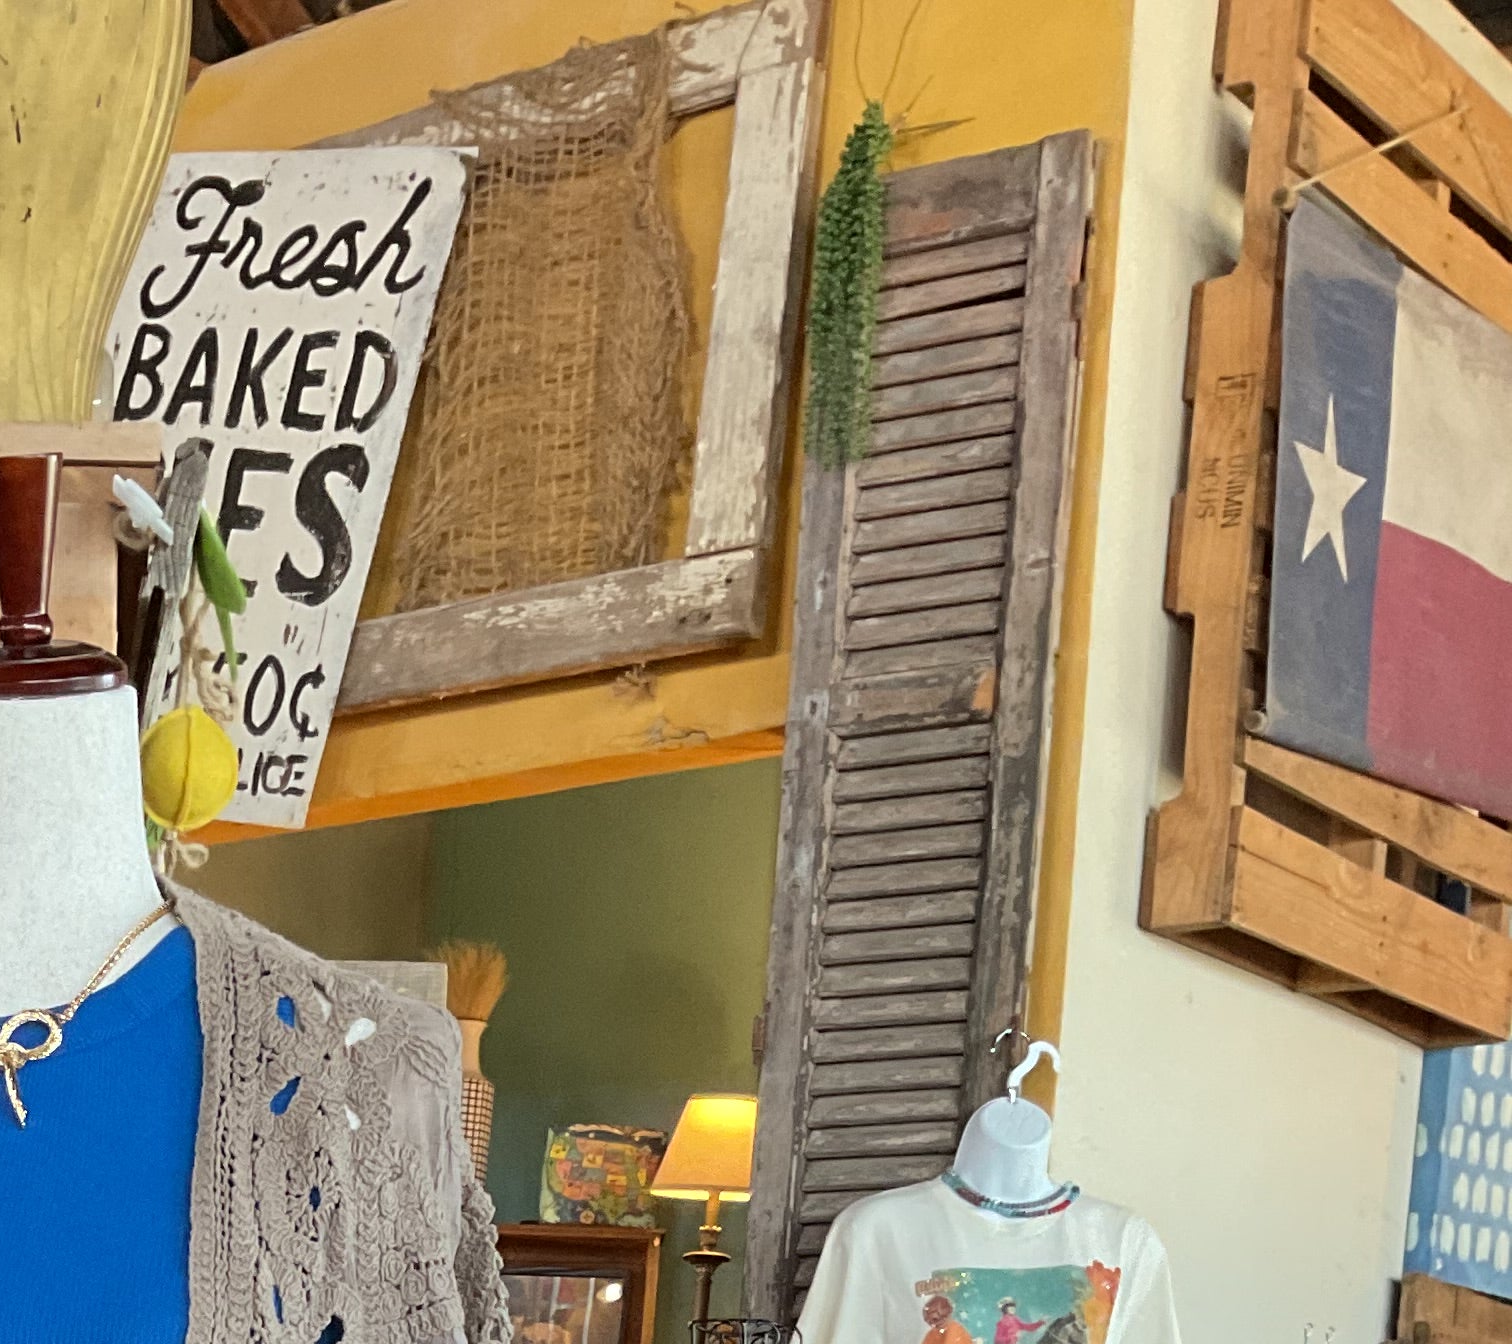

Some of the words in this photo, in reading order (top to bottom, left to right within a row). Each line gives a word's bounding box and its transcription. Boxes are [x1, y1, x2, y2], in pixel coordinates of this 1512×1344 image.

[138, 173, 433, 319] Fresh
[113, 323, 399, 432] BAKED
[200, 442, 372, 607] ES
[236, 748, 309, 798] LICE
